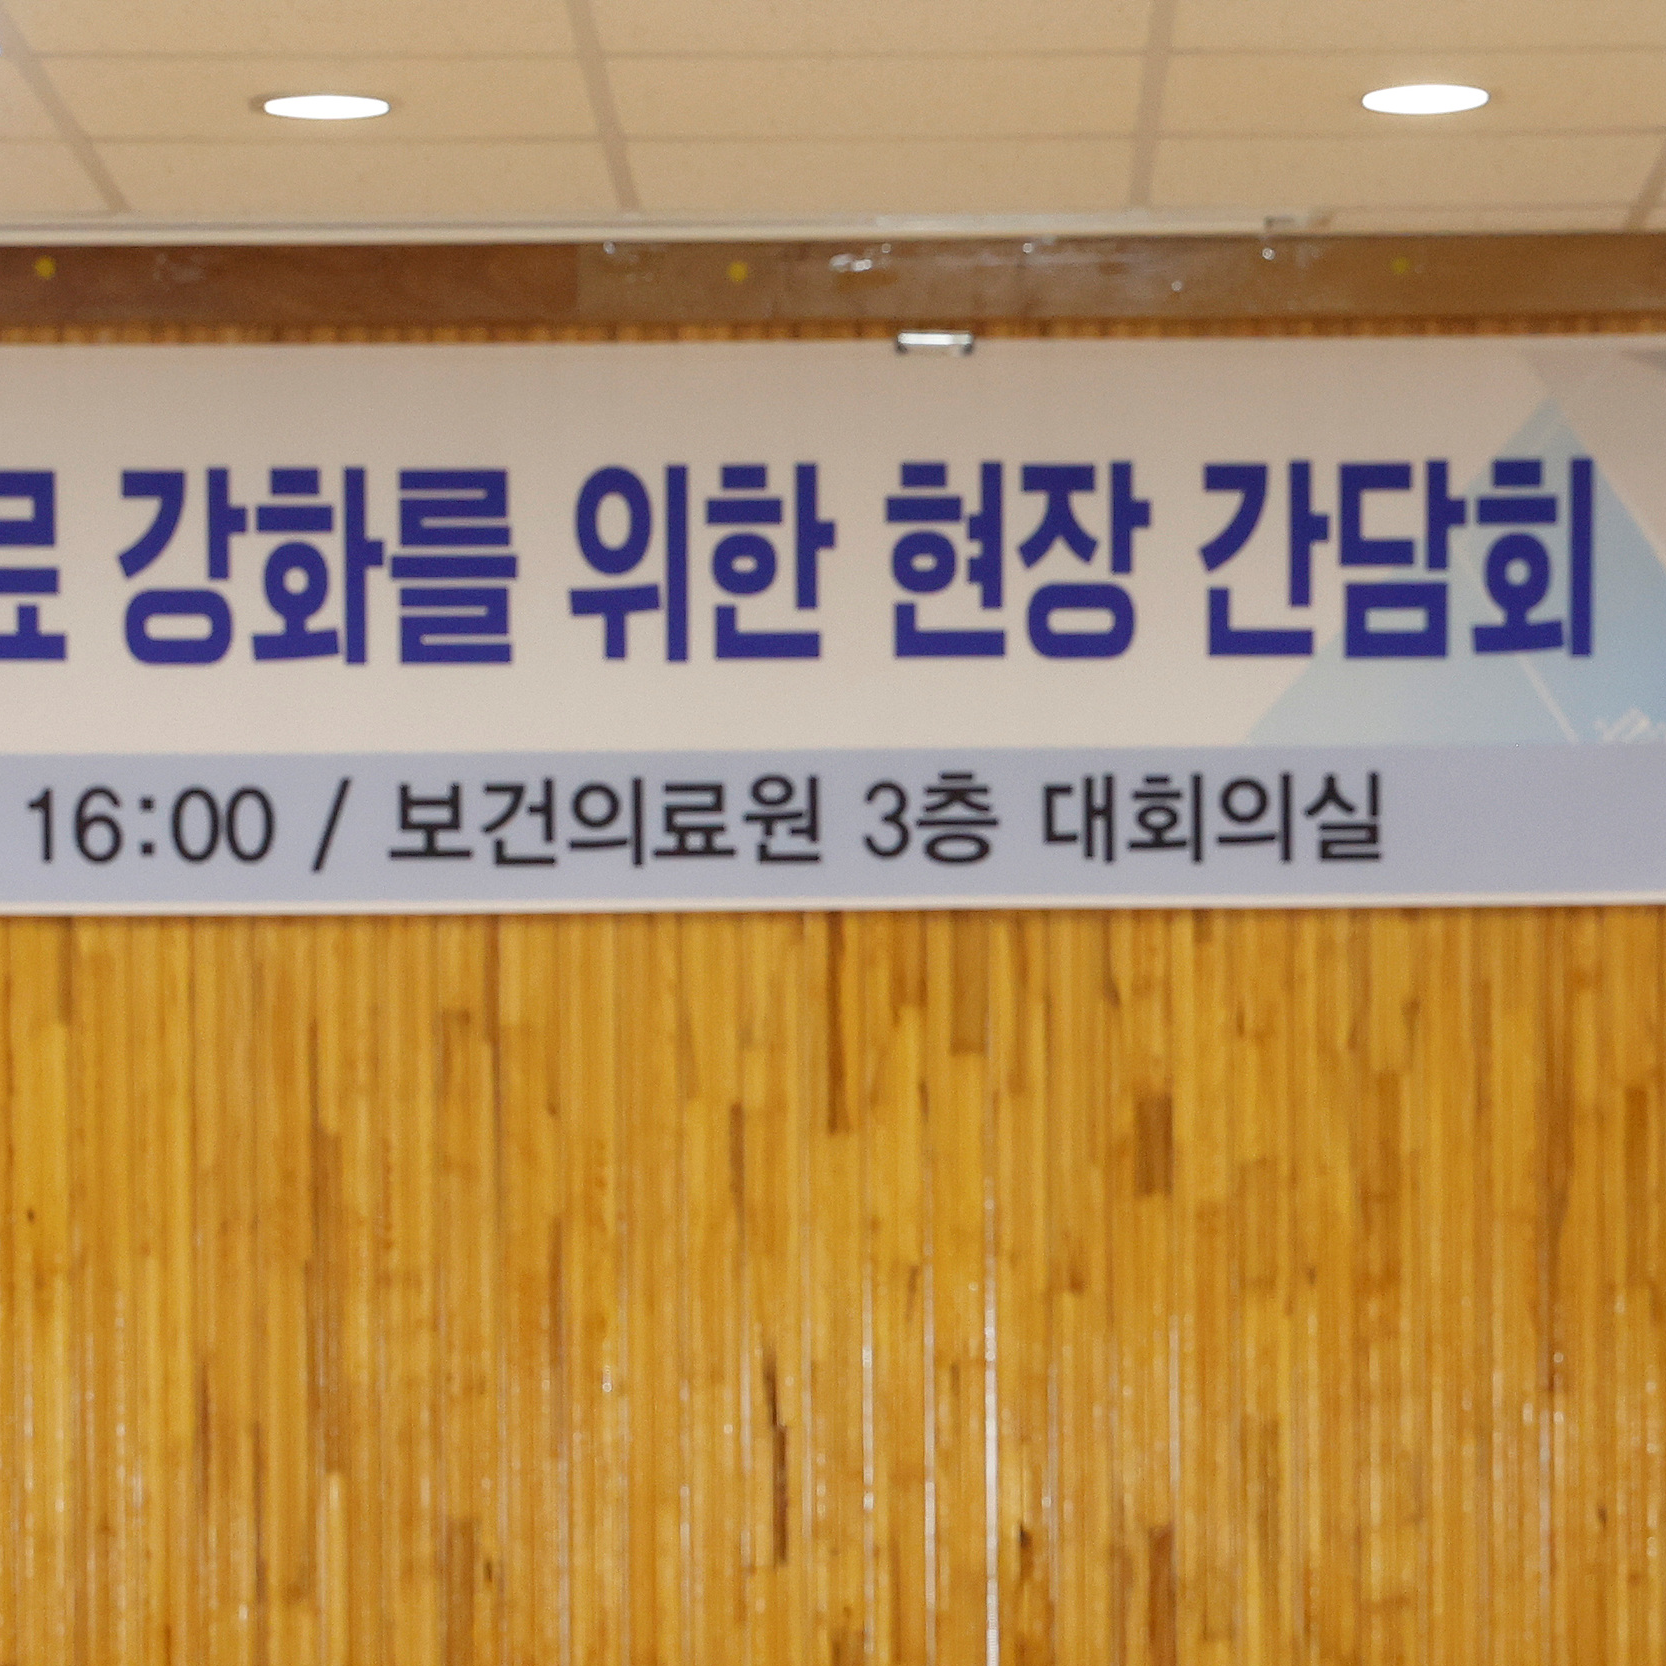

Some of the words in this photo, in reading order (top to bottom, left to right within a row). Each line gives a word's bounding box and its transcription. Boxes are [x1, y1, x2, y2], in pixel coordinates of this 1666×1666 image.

[118, 467, 519, 665] 강화를
[569, 463, 836, 662] 위한
[885, 461, 1151, 660] 현장
[1200, 457, 1595, 659] 간담회
[27, 785, 277, 866] 16:00
[386, 773, 823, 869] 보건의료원
[862, 770, 1001, 867] 3층
[1042, 770, 1383, 866] 대회의실
